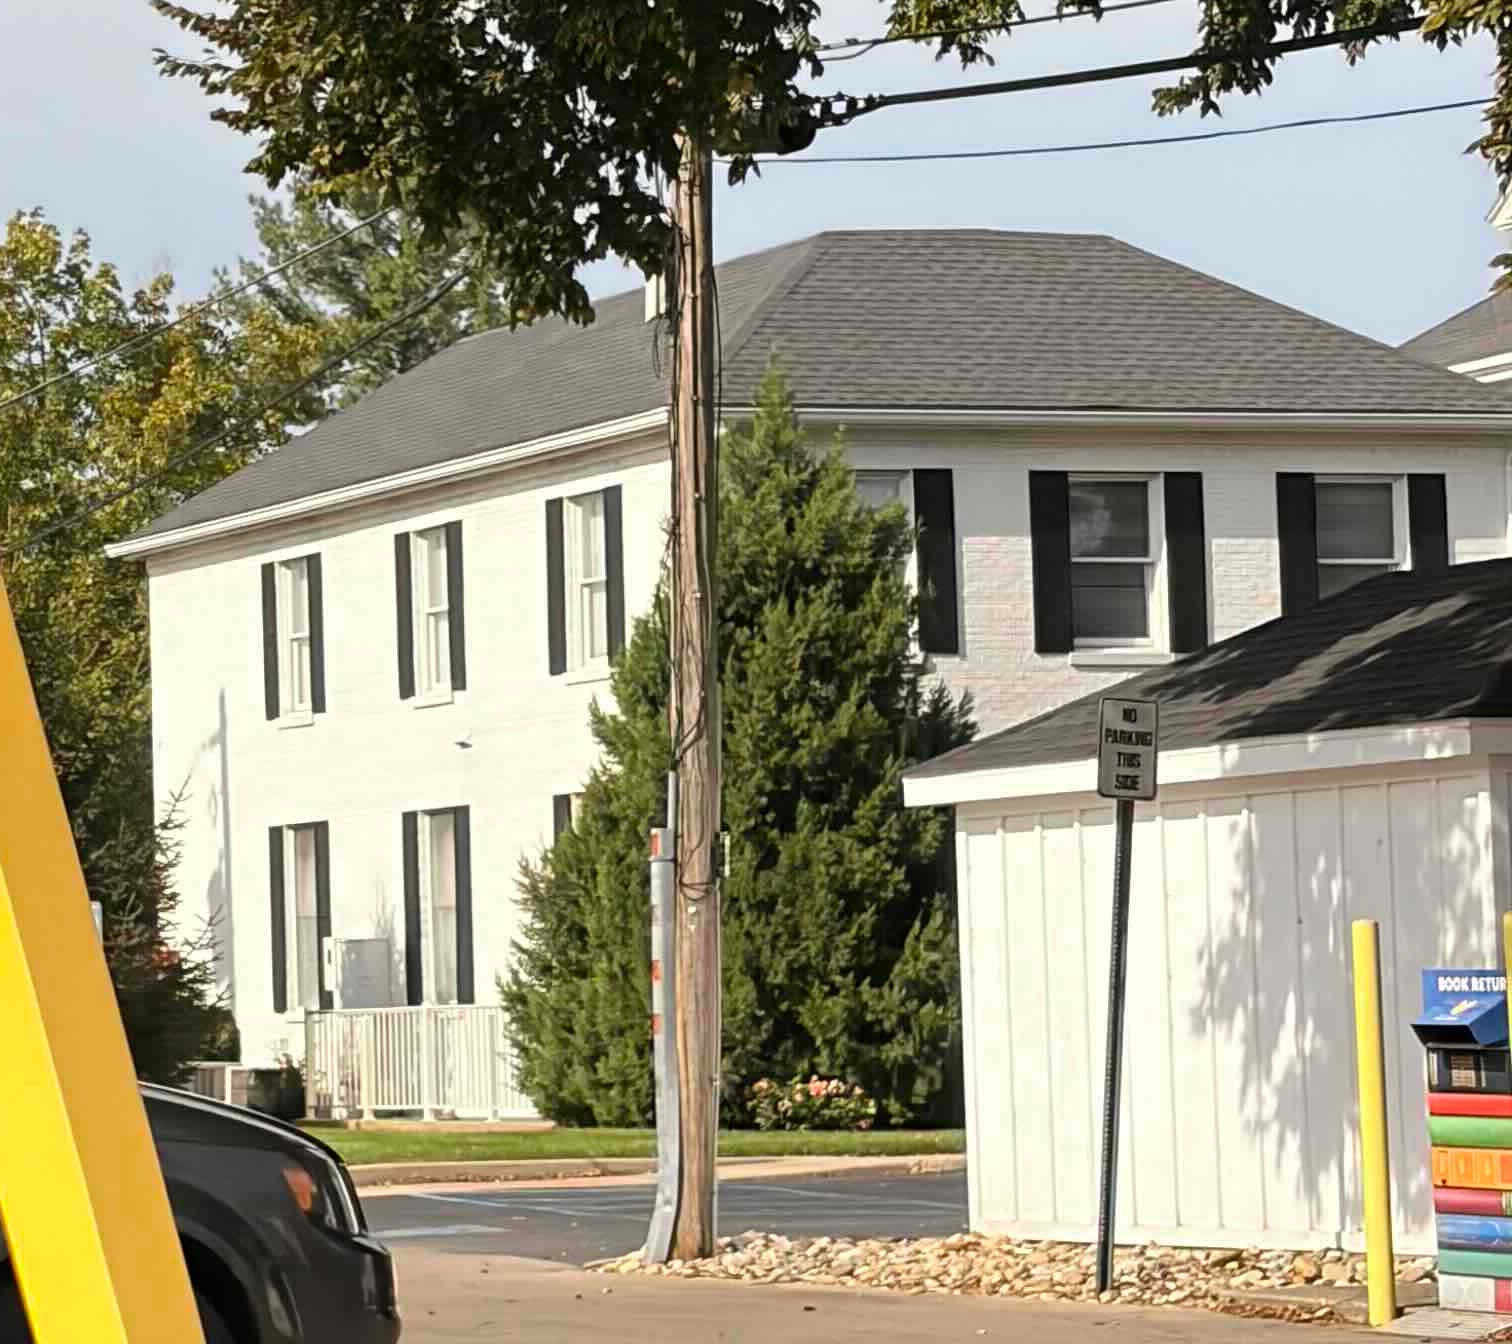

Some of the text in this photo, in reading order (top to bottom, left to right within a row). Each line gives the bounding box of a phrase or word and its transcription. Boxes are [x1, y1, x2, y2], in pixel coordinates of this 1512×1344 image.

[1122, 707, 1137, 723] NO
[1104, 728, 1153, 747] PARKING
[1117, 751, 1141, 768] THIS
[1114, 774, 1140, 791] SIDE
[1438, 976, 1506, 992] BOOK RETUR
